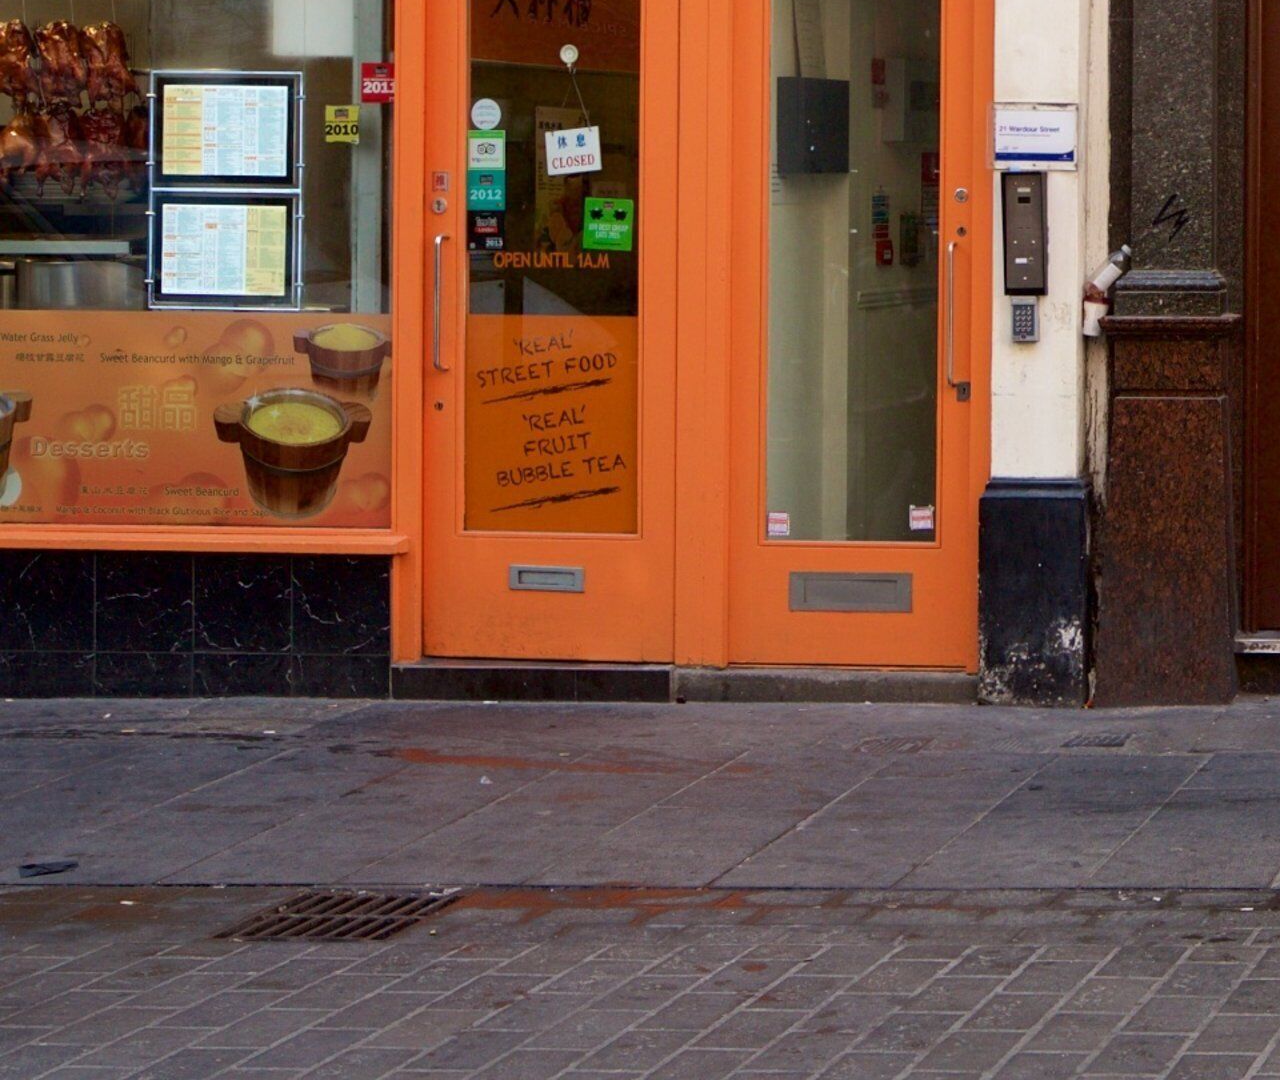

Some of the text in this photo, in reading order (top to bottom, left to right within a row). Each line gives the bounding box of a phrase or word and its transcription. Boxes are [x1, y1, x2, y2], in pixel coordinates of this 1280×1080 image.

[325, 124, 359, 136] 2010
[998, 125, 1007, 133] 21
[550, 153, 596, 171] CLOSED
[469, 188, 504, 201] 2012
[493, 251, 532, 270] OPEN
[534, 251, 574, 270] UNTIL
[30, 332, 55, 342] Grass
[57, 332, 79, 345] Jelly
[99, 353, 296, 368] Sweet Beancurd with Mango & Grapefruit
[476, 351, 618, 389] STREET FOOD
[29, 435, 151, 459] Desserts
[523, 431, 592, 457] FRUIT
[496, 454, 627, 488] BUBBLE TEA
[164, 486, 240, 497] Sweet Beancurd
[93, 505, 127, 516] Coconut
[127, 506, 147, 516] with
[149, 506, 171, 516] Black
